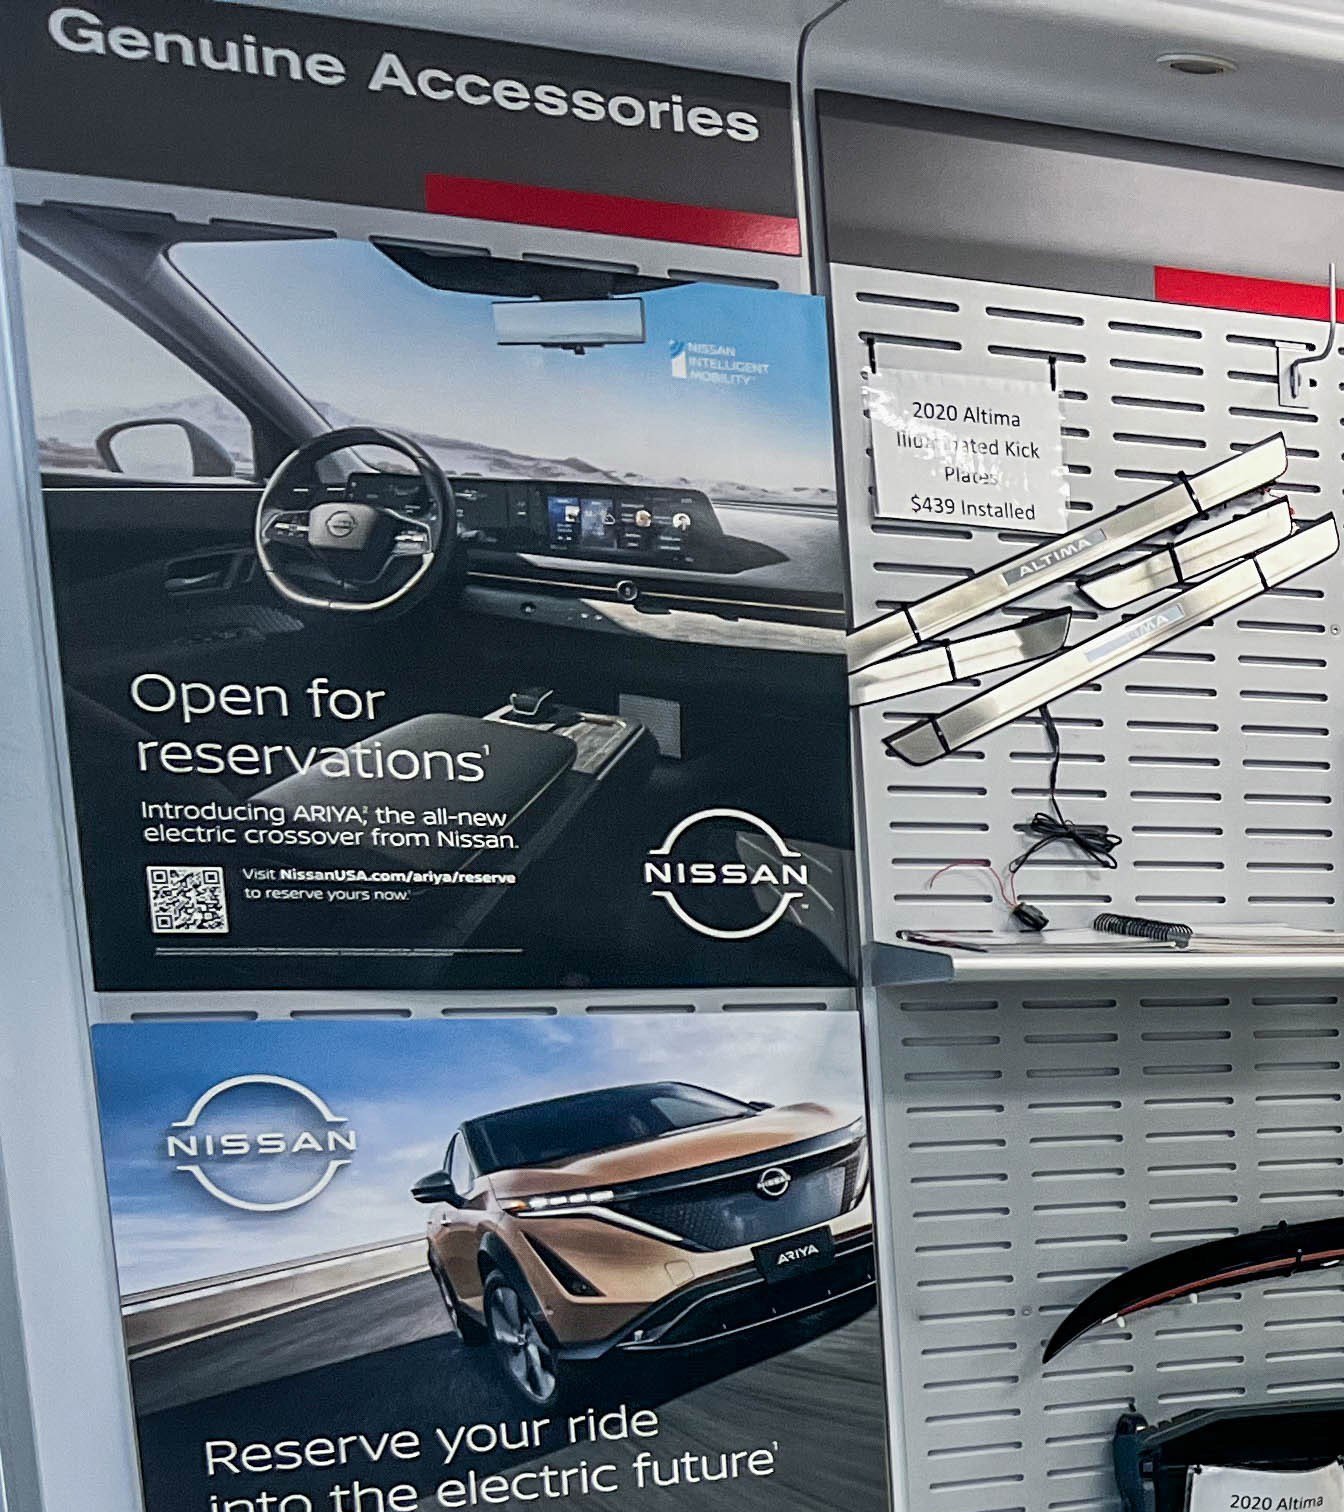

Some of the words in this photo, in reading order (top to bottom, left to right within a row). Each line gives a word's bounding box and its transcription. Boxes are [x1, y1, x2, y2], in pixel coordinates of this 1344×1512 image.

[48, 7, 346, 86] Genuine
[368, 51, 760, 142] Accessories
[912, 402, 958, 421] 2020
[963, 407, 1021, 427] Altima
[1006, 441, 1040, 459] Kick
[911, 494, 955, 515] $439
[962, 500, 1036, 520] Installed
[1019, 537, 1092, 577] ALTIMA
[130, 673, 289, 723] Open
[306, 678, 385, 720] for
[141, 802, 285, 825] Introducing
[375, 805, 415, 825] the
[423, 808, 507, 827] all-new
[144, 824, 237, 844] electric
[245, 828, 361, 846] crossover
[372, 827, 430, 847] from
[438, 830, 519, 850] Nissan.
[242, 868, 276, 880] Visit
[280, 868, 517, 885] NissanUSA.com/ariya/reserve
[644, 862, 808, 885] NISSAN
[245, 888, 261, 900] to
[265, 890, 323, 900] reserve
[327, 890, 371, 902] yours
[168, 1130, 357, 1157] NISSAN
[777, 1244, 820, 1265] ARIYA
[205, 1430, 421, 1475] Reserve
[436, 1417, 550, 1464] your
[567, 1404, 659, 1443] ride
[436, 1461, 618, 1508] electric
[1230, 1494, 1272, 1511] 2020
[1276, 1496, 1324, 1511] Altima
